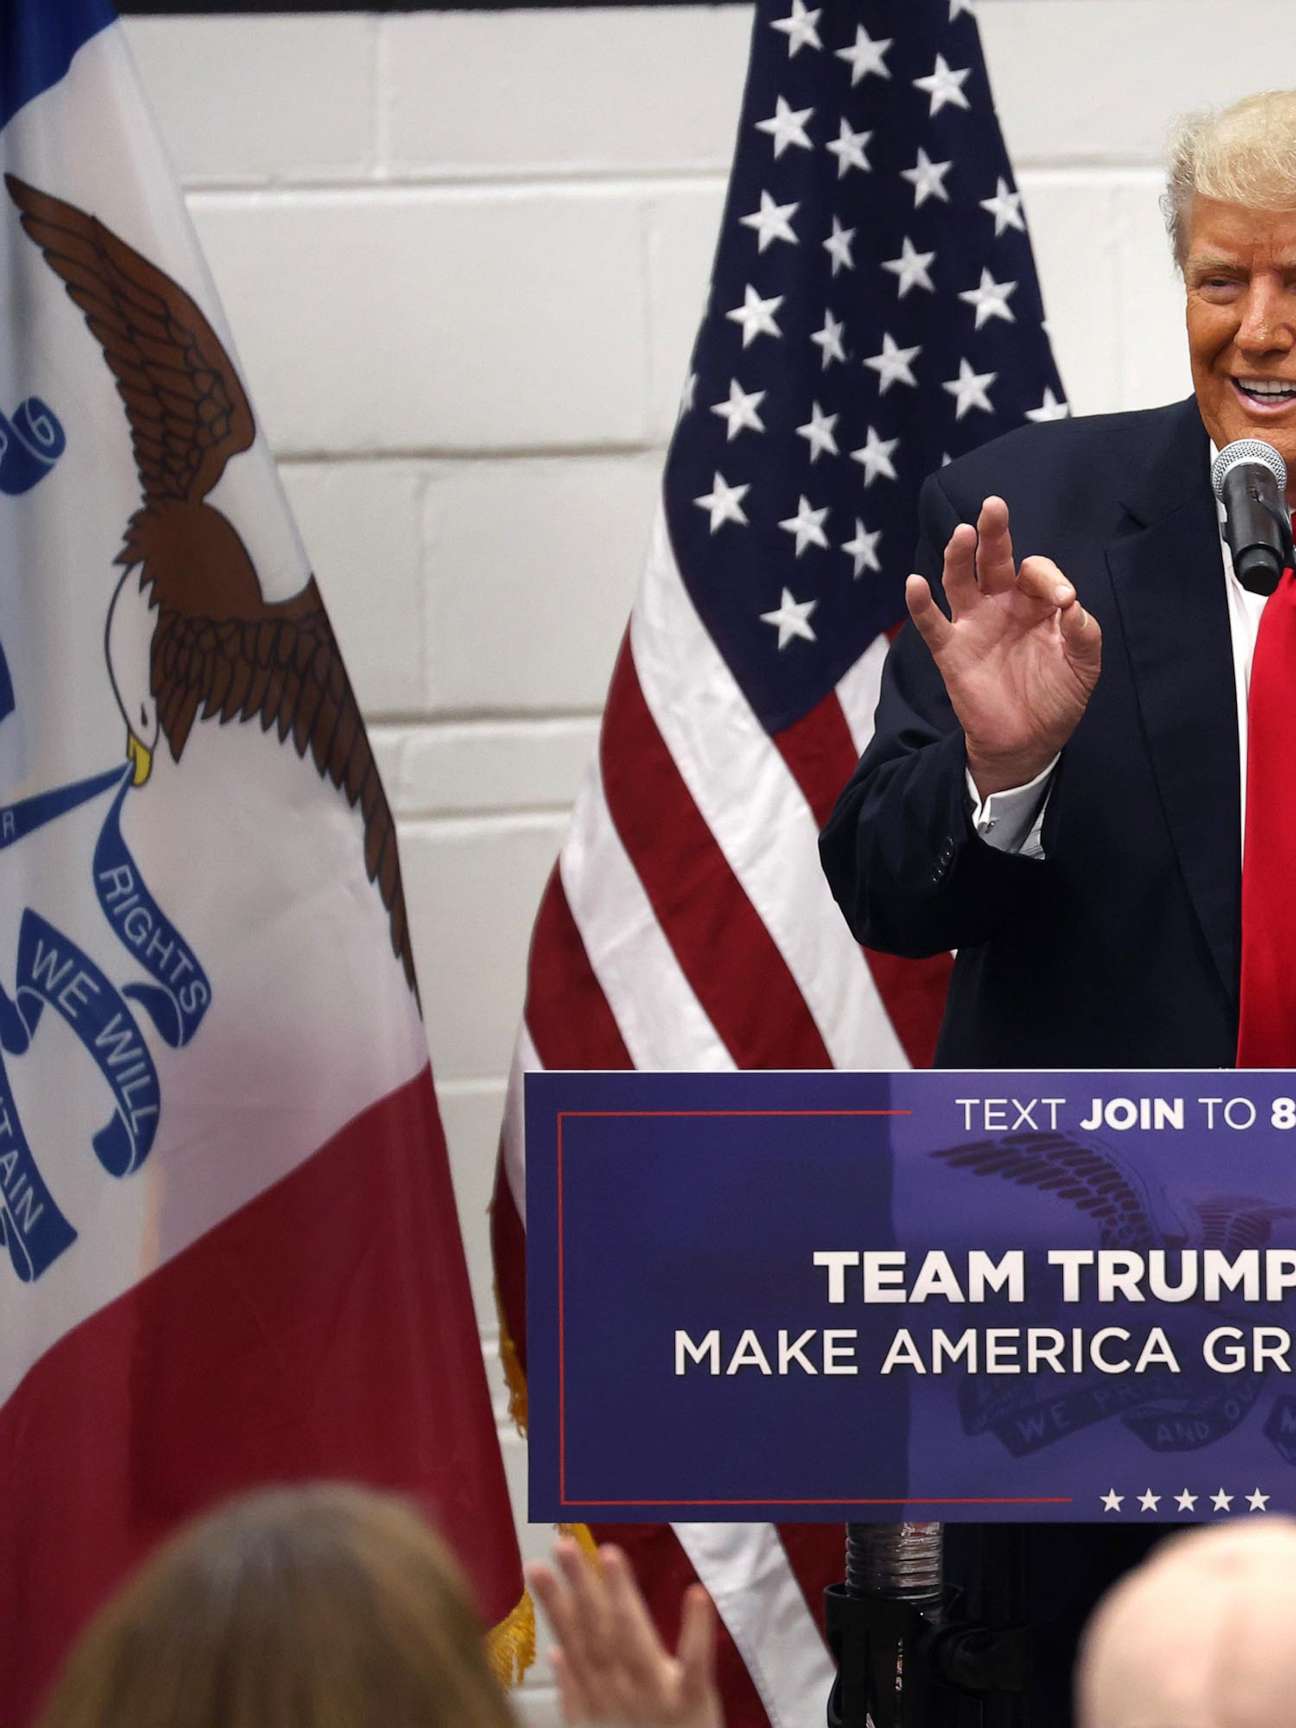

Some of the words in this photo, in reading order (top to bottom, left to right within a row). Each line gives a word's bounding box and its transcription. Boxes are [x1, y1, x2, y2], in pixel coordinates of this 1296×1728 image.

[99, 864, 208, 1015] RIGHTS
[31, 939, 100, 1020] WE
[94, 1012, 158, 1136] WILL
[954, 1098, 1067, 1131] TEXT
[1079, 1097, 1185, 1131] JOIN
[1197, 1097, 1257, 1130] TO
[813, 1250, 1025, 1304] TEAM
[674, 1329, 859, 1375] MAKE
[880, 1326, 1181, 1374] AMERICA
[1156, 1421, 1210, 1444] AND
